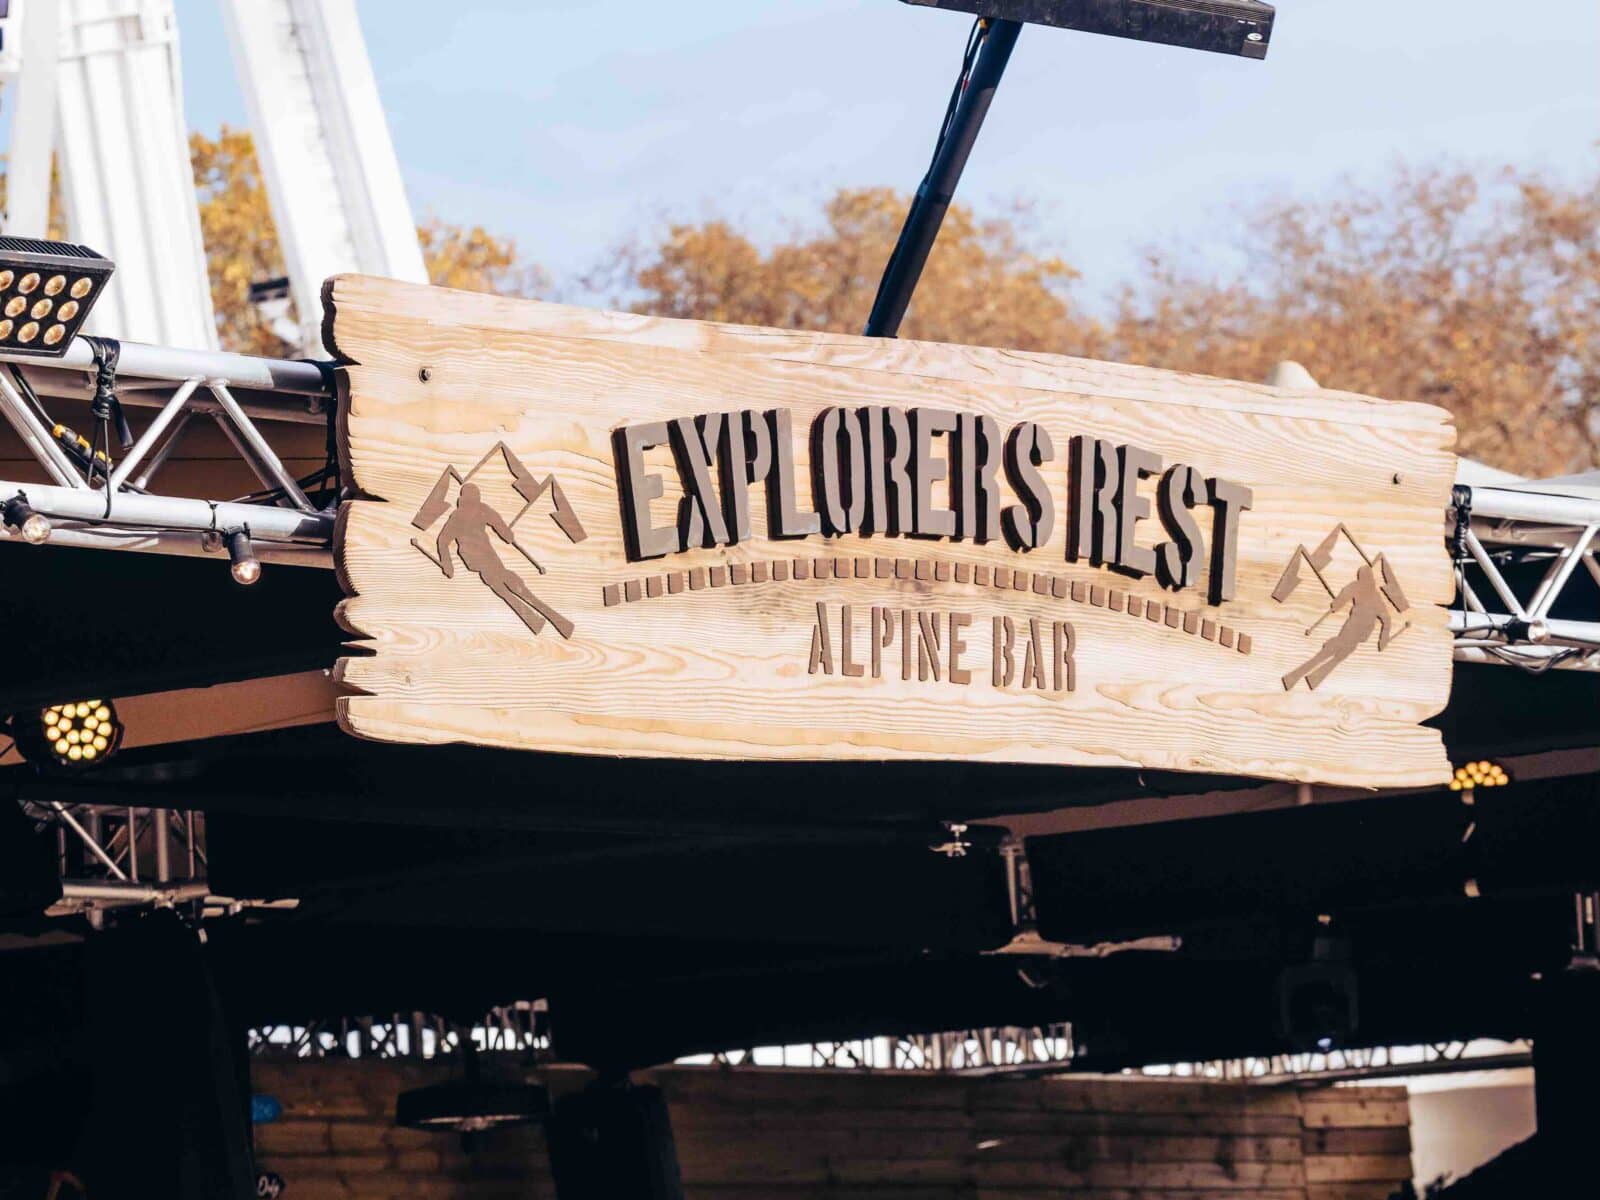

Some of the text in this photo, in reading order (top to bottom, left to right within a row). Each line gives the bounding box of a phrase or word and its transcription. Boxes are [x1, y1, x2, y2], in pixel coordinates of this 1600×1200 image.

[610, 406, 1253, 606] EXPLORERS REST
[807, 601, 1077, 692] ALPINE BAR
